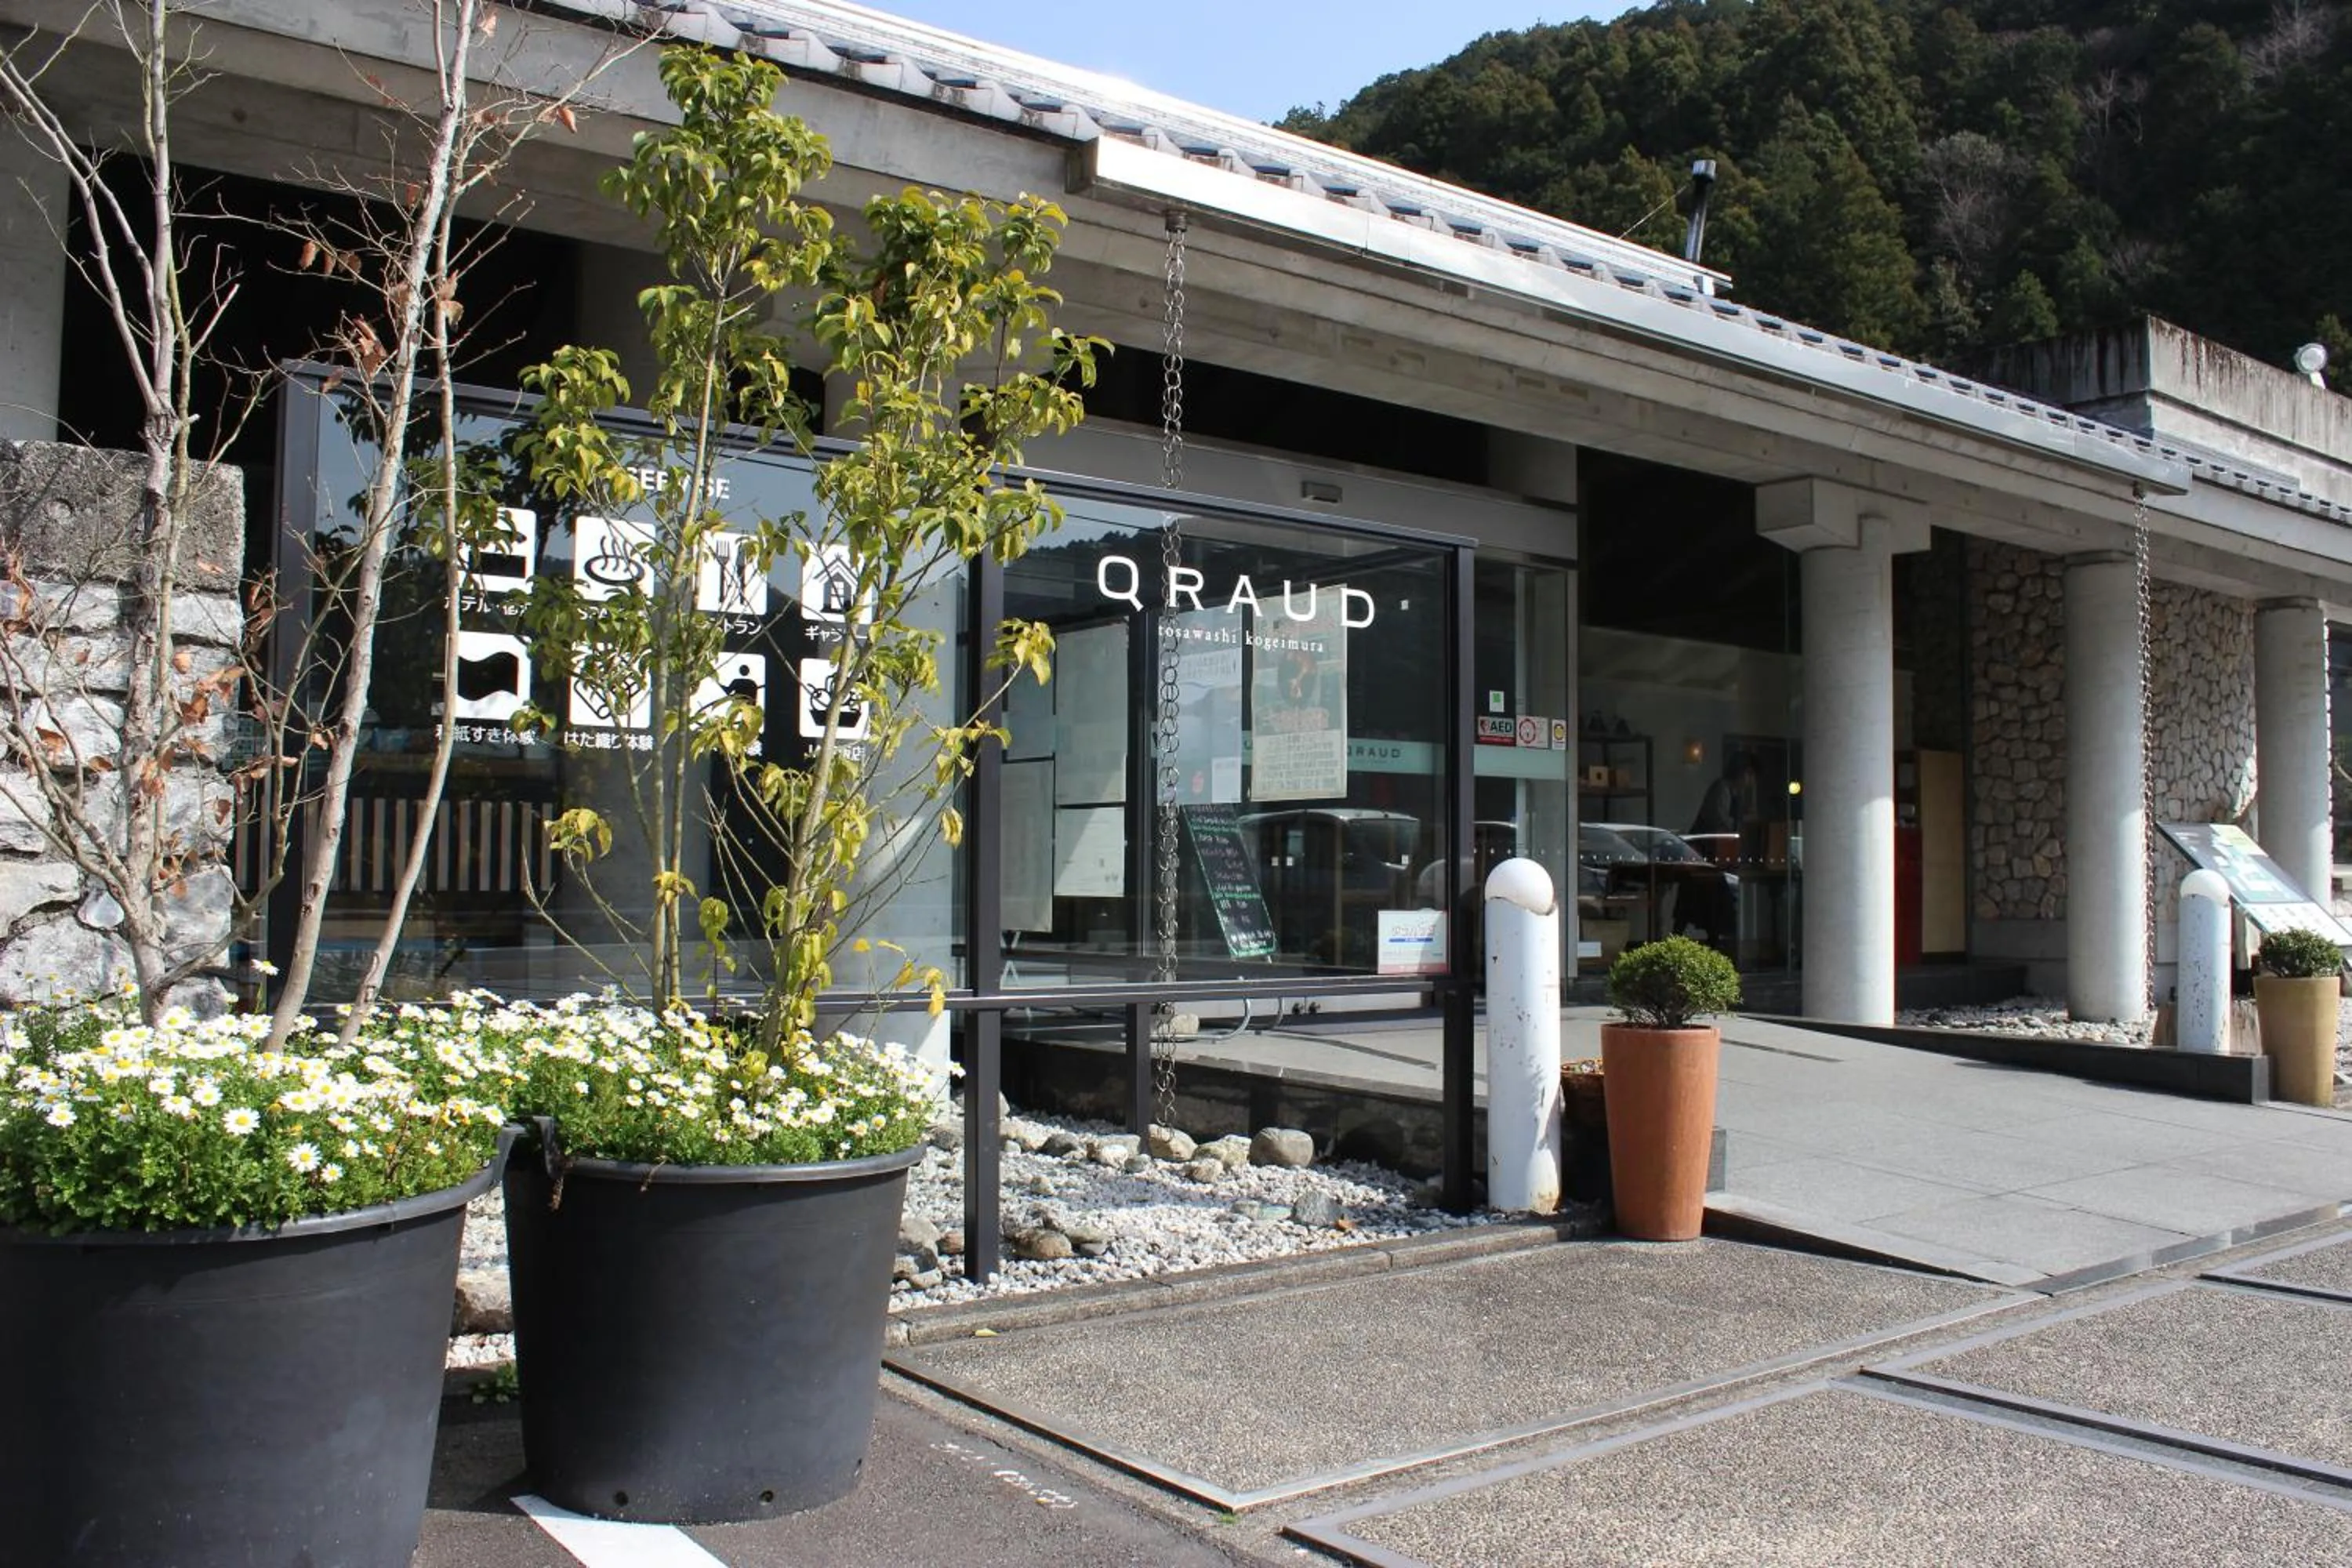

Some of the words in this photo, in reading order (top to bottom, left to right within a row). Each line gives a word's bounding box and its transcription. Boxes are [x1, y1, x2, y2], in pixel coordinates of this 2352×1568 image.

[1098, 555, 1375, 628] QRAUD
[1158, 625, 1236, 644] tosawashi
[1246, 630, 1323, 653] kogeimura
[1490, 720, 1512, 733] AED
